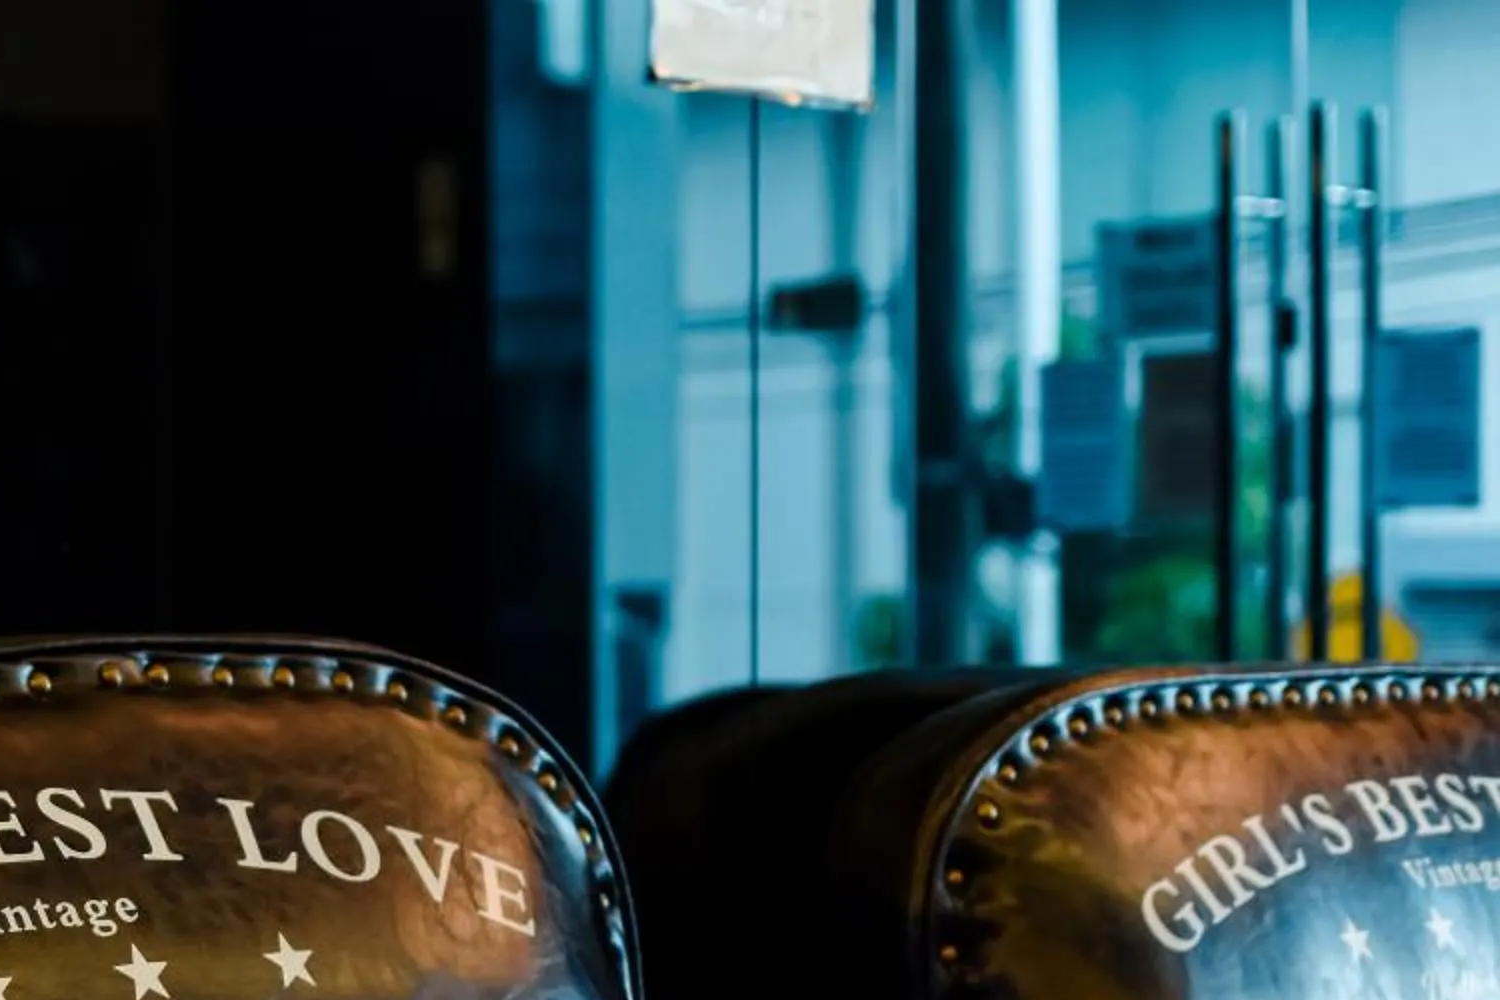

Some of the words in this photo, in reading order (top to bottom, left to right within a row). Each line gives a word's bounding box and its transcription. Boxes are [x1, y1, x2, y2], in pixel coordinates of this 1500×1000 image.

[216, 797, 537, 937] LOVE
[1141, 793, 1354, 953] GIRL'S
[1402, 857, 1500, 891] Vintag
